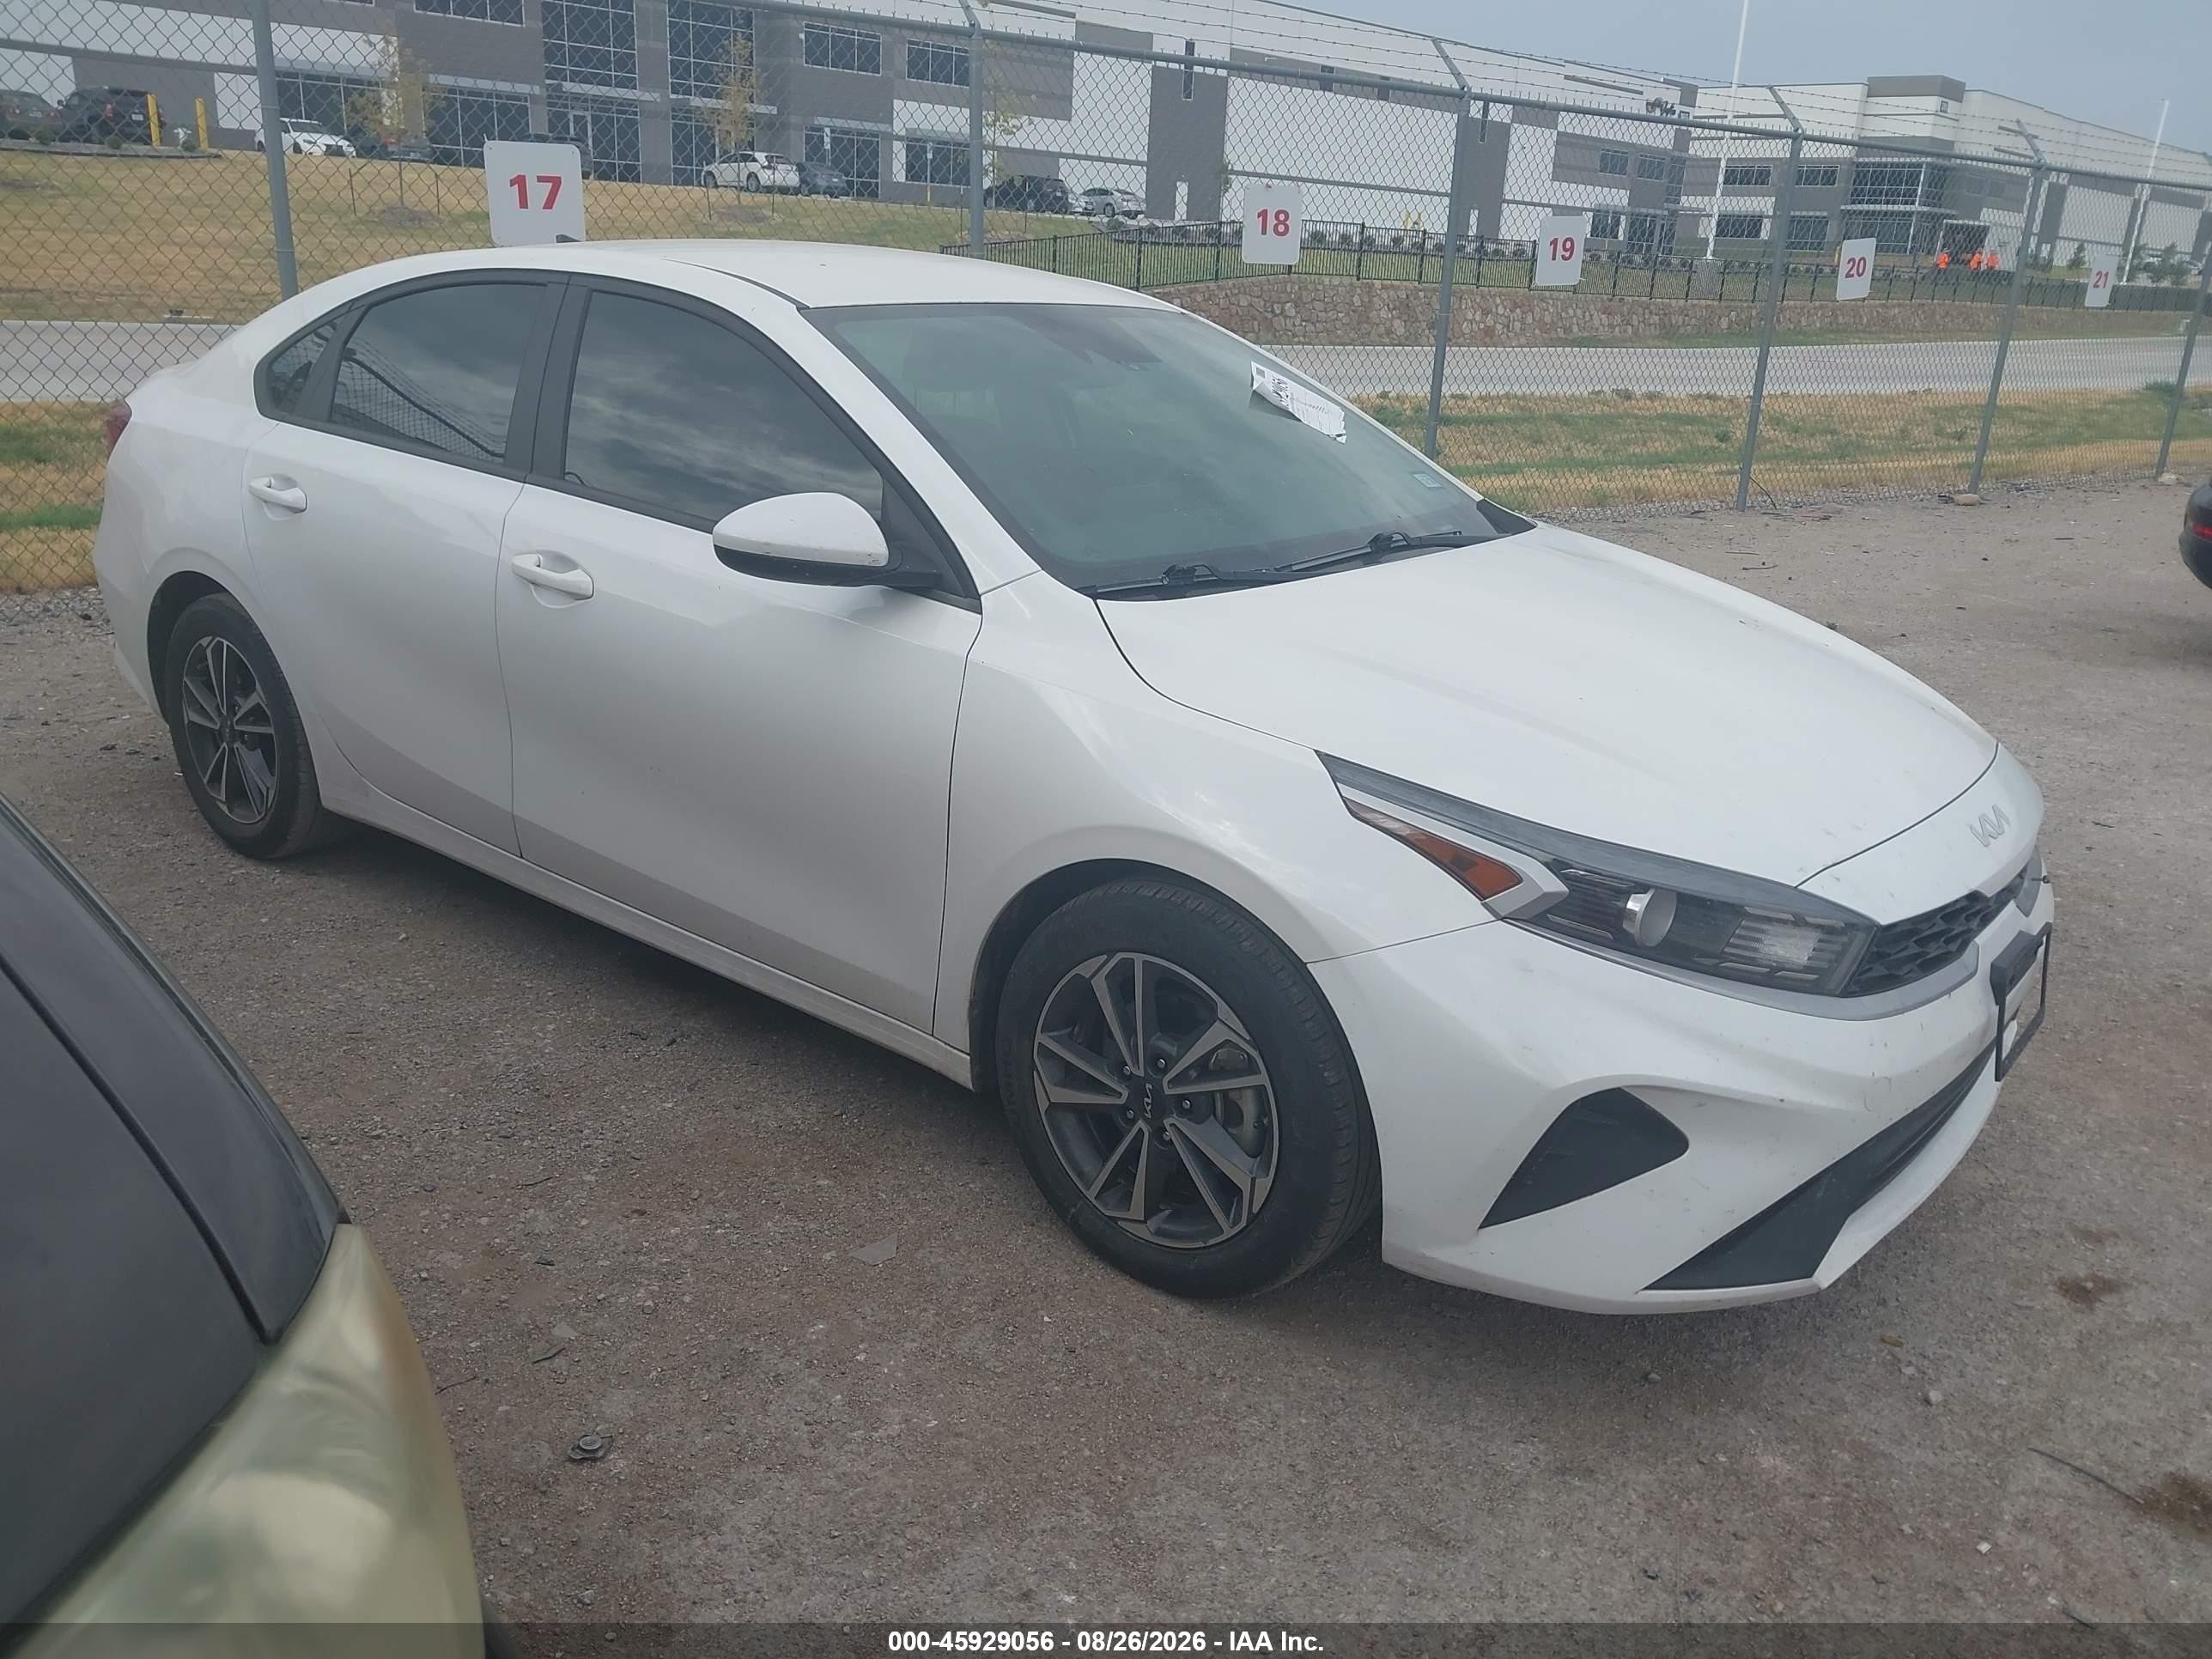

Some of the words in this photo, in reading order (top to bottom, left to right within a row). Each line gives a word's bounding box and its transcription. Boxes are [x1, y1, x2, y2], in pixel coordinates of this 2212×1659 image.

[509, 174, 562, 210] 17
[1257, 209, 1290, 236] 18
[1549, 237, 1575, 261] 19
[1844, 257, 1867, 279] 20
[2093, 270, 2109, 289] 21
